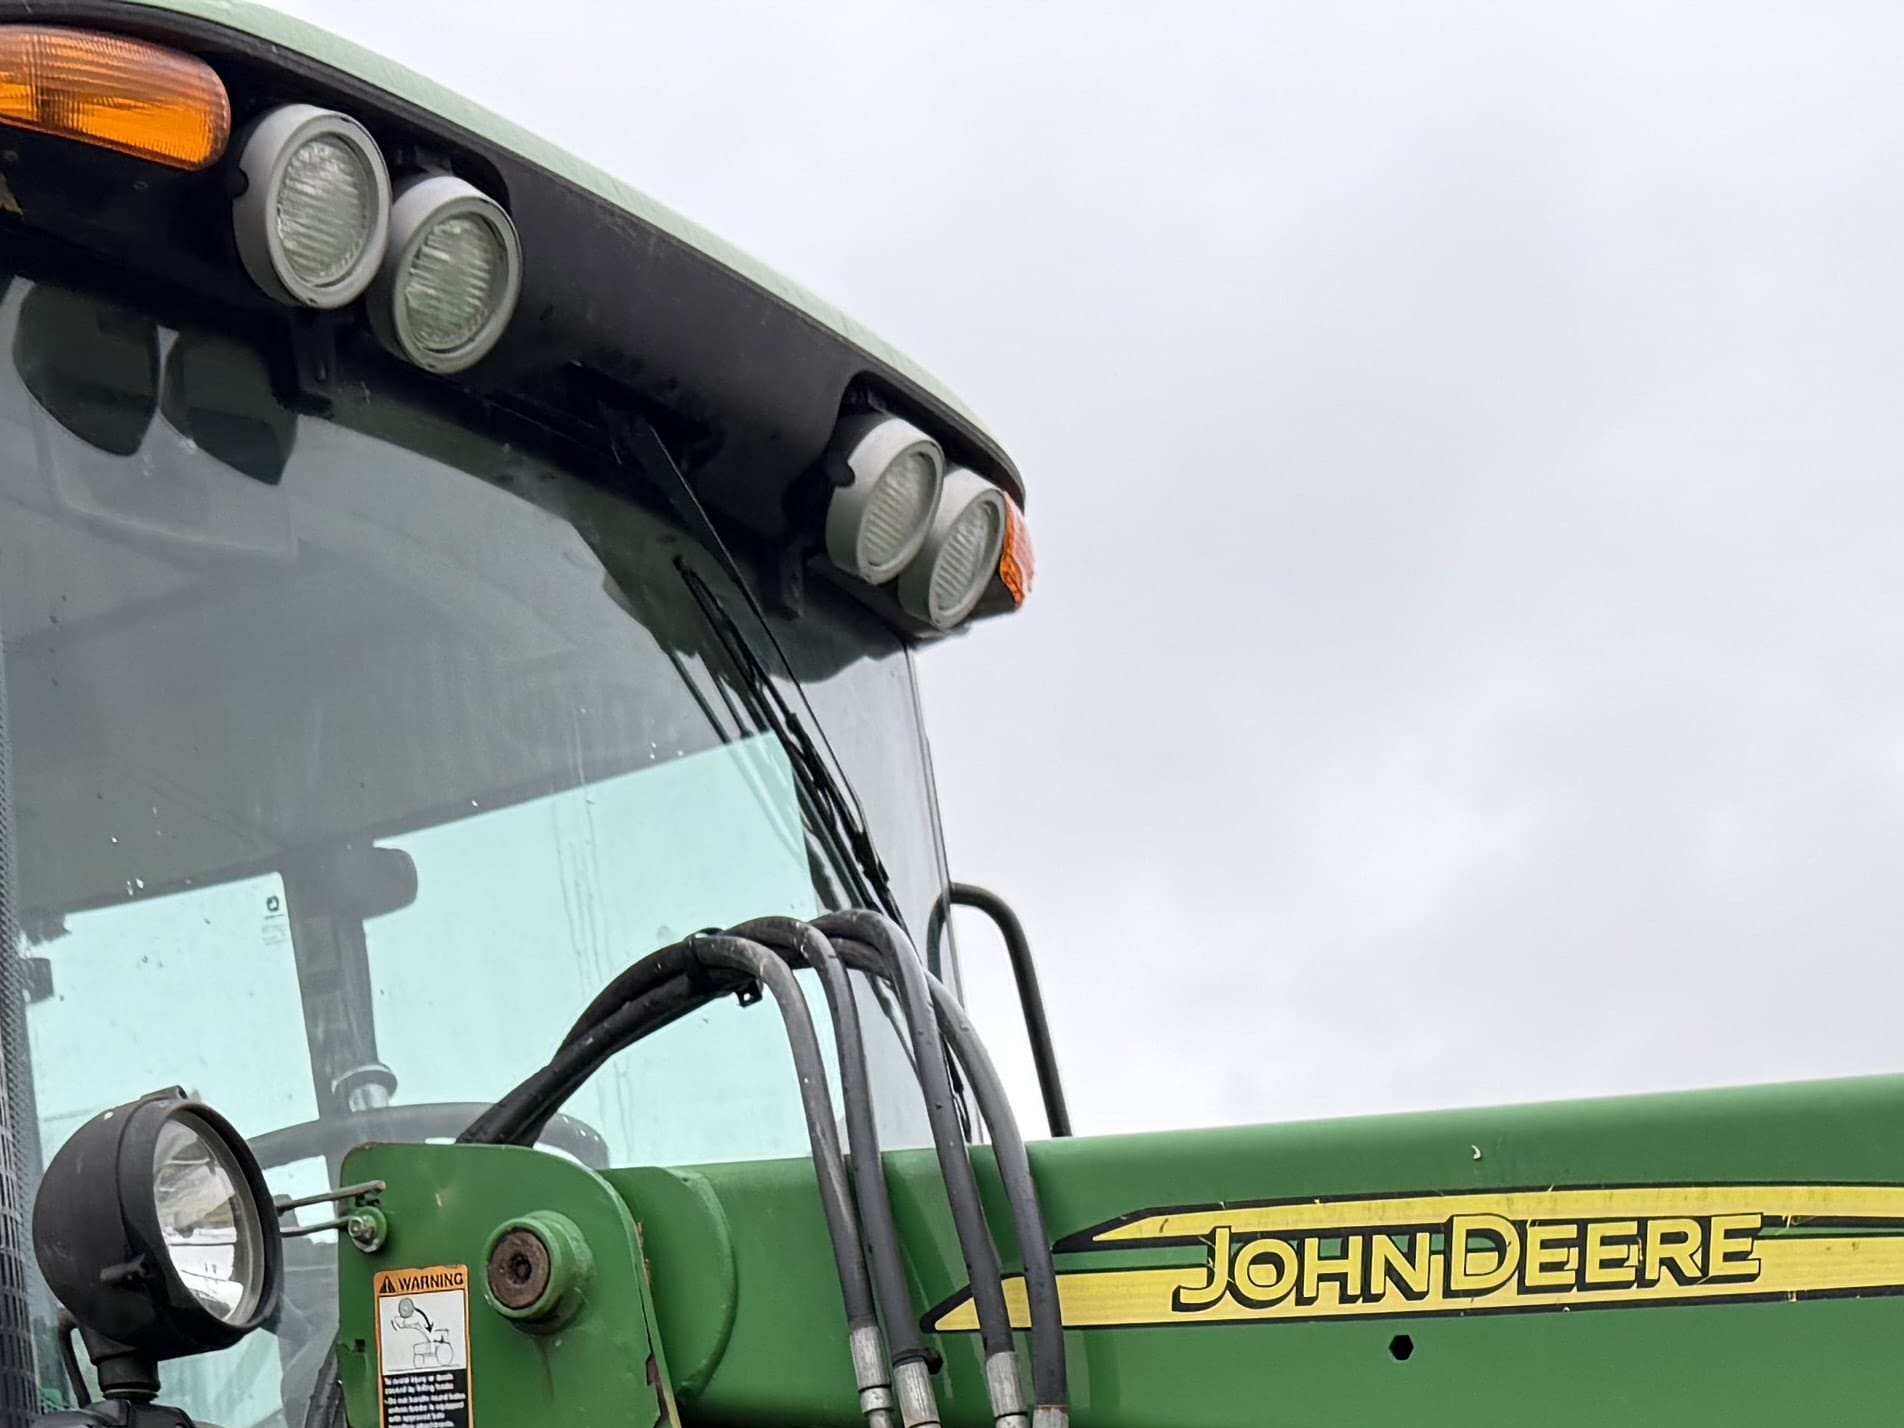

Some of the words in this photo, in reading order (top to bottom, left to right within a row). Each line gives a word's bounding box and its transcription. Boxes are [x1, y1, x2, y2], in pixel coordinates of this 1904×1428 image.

[398, 1272, 465, 1292] WARNING
[1172, 1225, 1434, 1312] JOHN
[1449, 1211, 1764, 1290] DEERE
